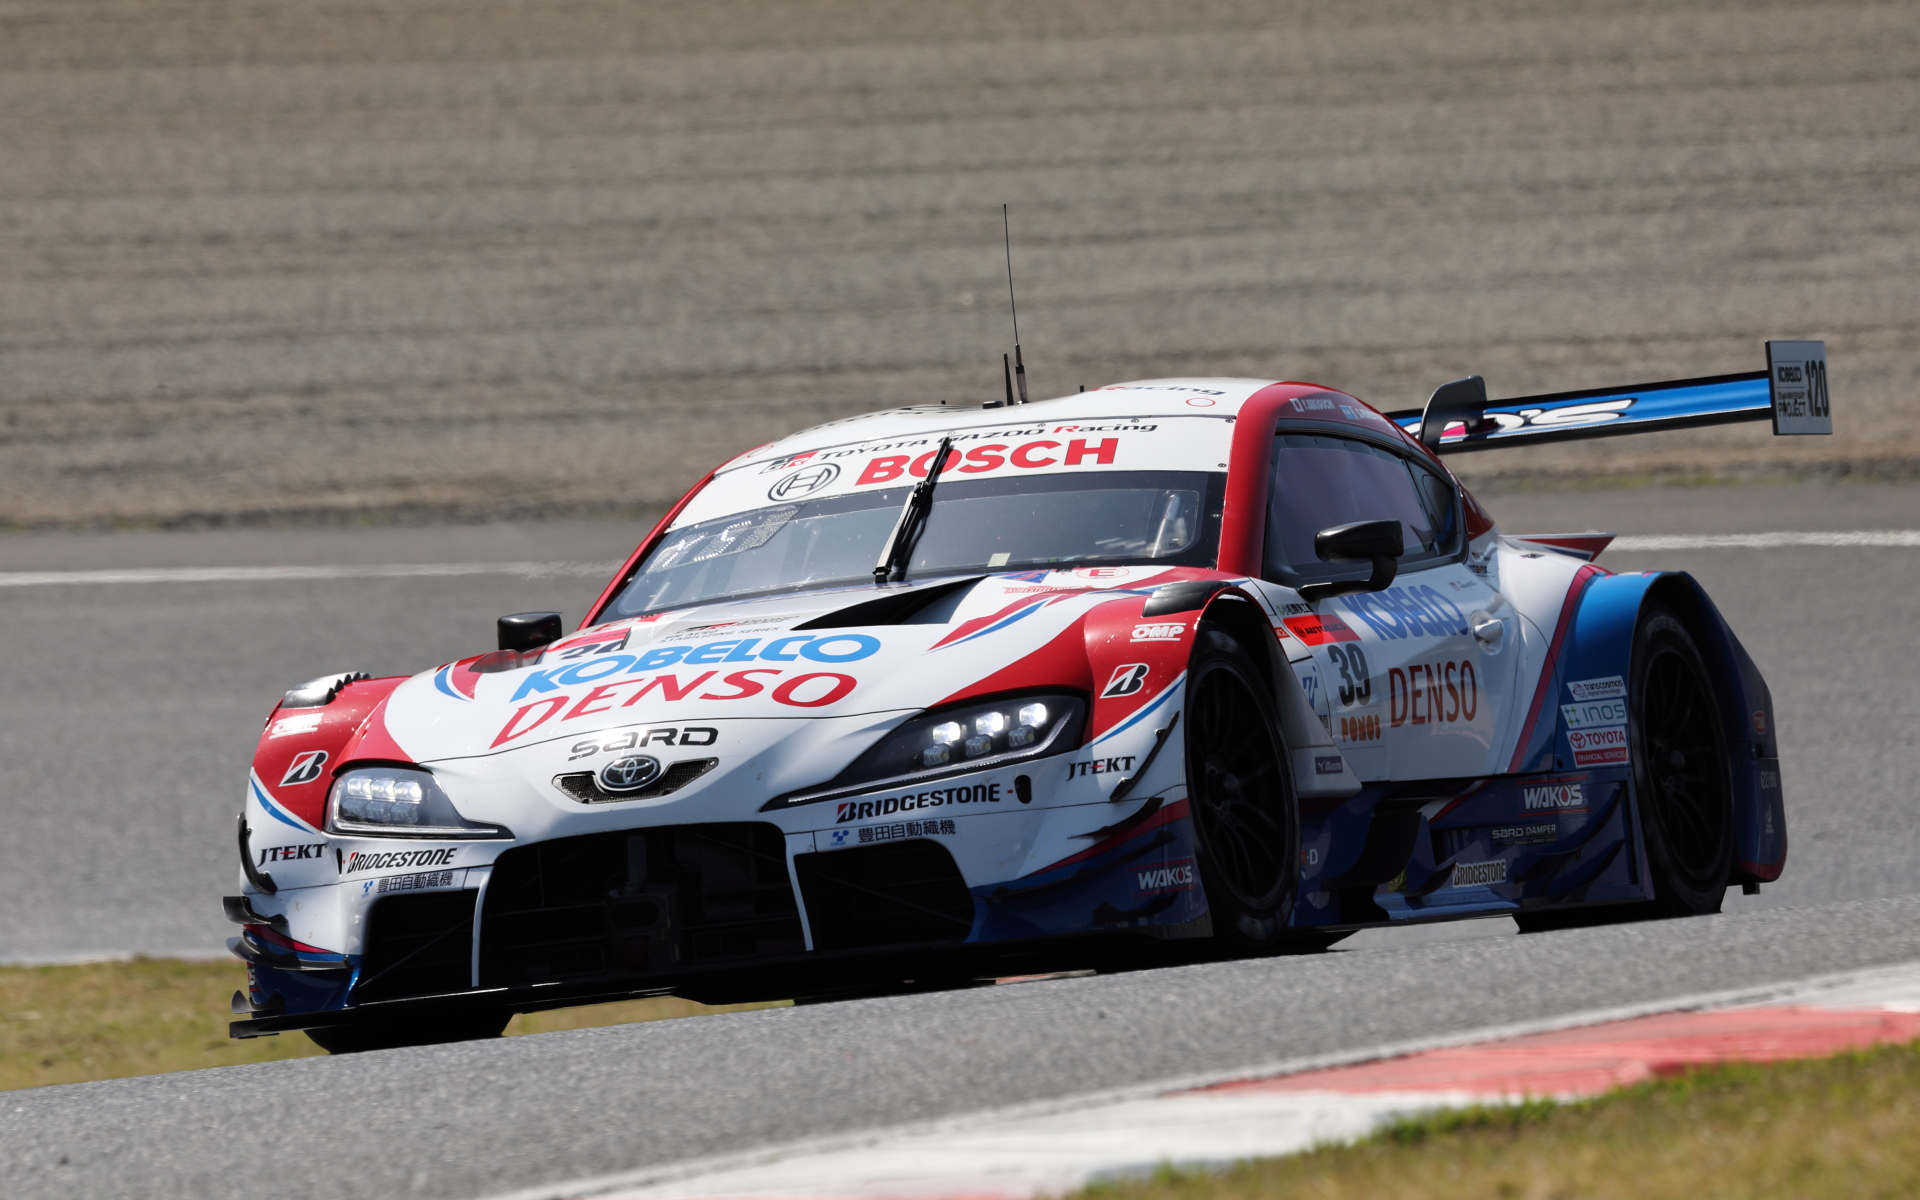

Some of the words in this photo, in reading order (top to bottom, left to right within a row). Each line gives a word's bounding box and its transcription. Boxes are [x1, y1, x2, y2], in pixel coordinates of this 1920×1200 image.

[1805, 360, 1829, 417] 120
[820, 439, 927, 460] TOYOTA
[937, 427, 1045, 444] GAZOO
[1053, 423, 1158, 434] Racing
[855, 438, 1119, 486] BOSCH
[1131, 625, 1185, 639] OMP
[509, 633, 882, 702] KOBELCO
[1327, 643, 1370, 707] 39
[1388, 660, 1478, 728] DENSO
[1584, 680, 1623, 691] transcosmos
[489, 669, 857, 750] DENSO
[1341, 714, 1381, 742] PONOS
[1586, 731, 1626, 745] TOYOTA
[1067, 756, 1136, 781] JTEKT
[1578, 753, 1603, 761] FINANCIAL
[1604, 751, 1625, 759] SERVICES
[836, 783, 1000, 823] BRIDGESTONE
[1526, 824, 1556, 835] DAMPER
[257, 844, 327, 867] JTEKT
[347, 848, 457, 874] BRIDGESTONE
[1453, 861, 1506, 887] BRIDGESTONE
